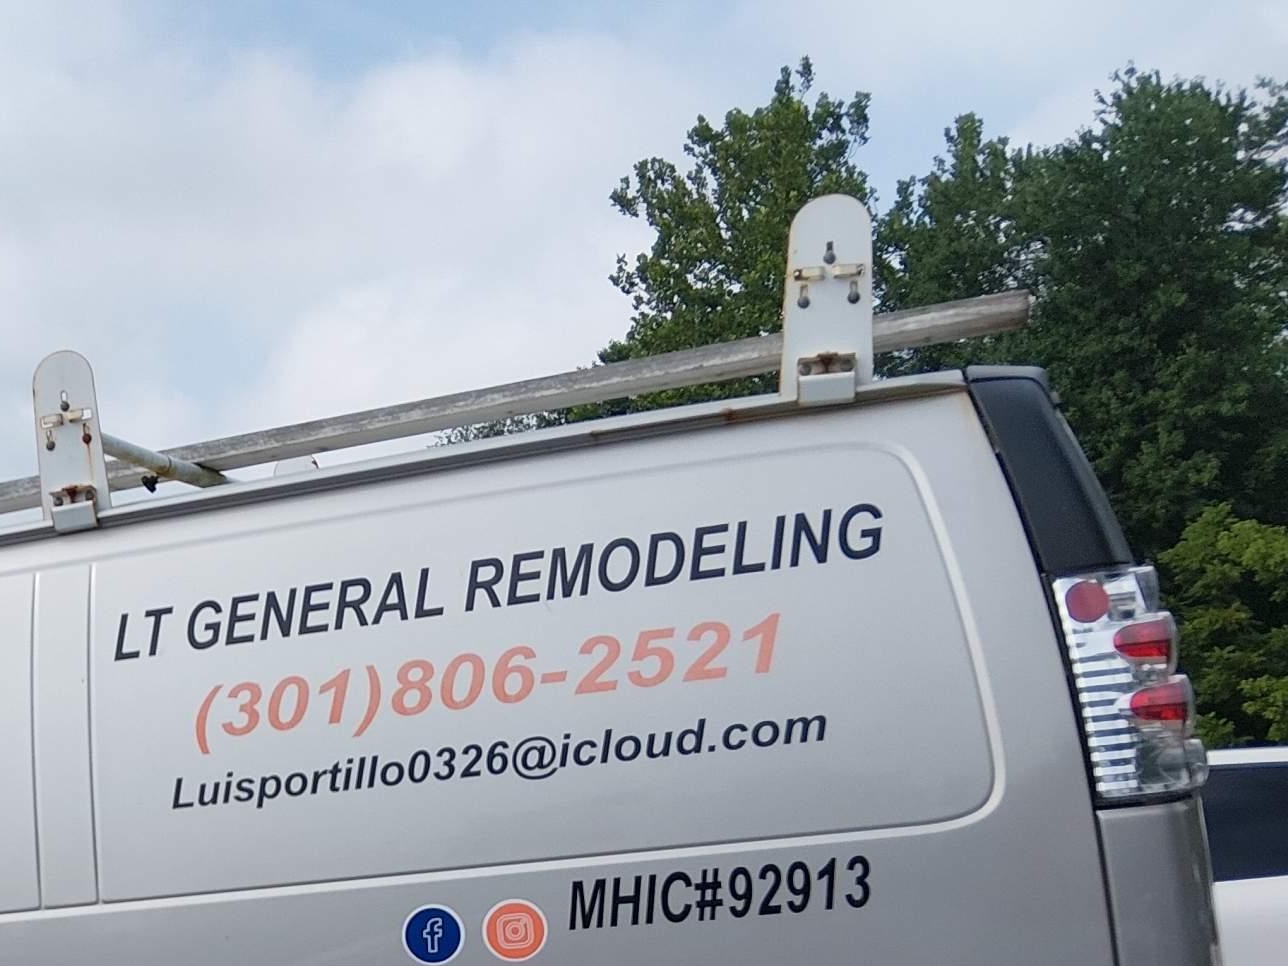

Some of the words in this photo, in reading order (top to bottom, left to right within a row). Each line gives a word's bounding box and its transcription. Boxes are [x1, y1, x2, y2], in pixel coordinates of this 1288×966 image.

[114, 606, 174, 662] LT
[186, 566, 444, 650] GENERAL
[464, 502, 885, 612] REMODELING
[194, 612, 784, 756] (301)806-2521
[172, 710, 828, 810] Luisportillo0326@icloud.com
[567, 854, 873, 932] MHIC#92913
